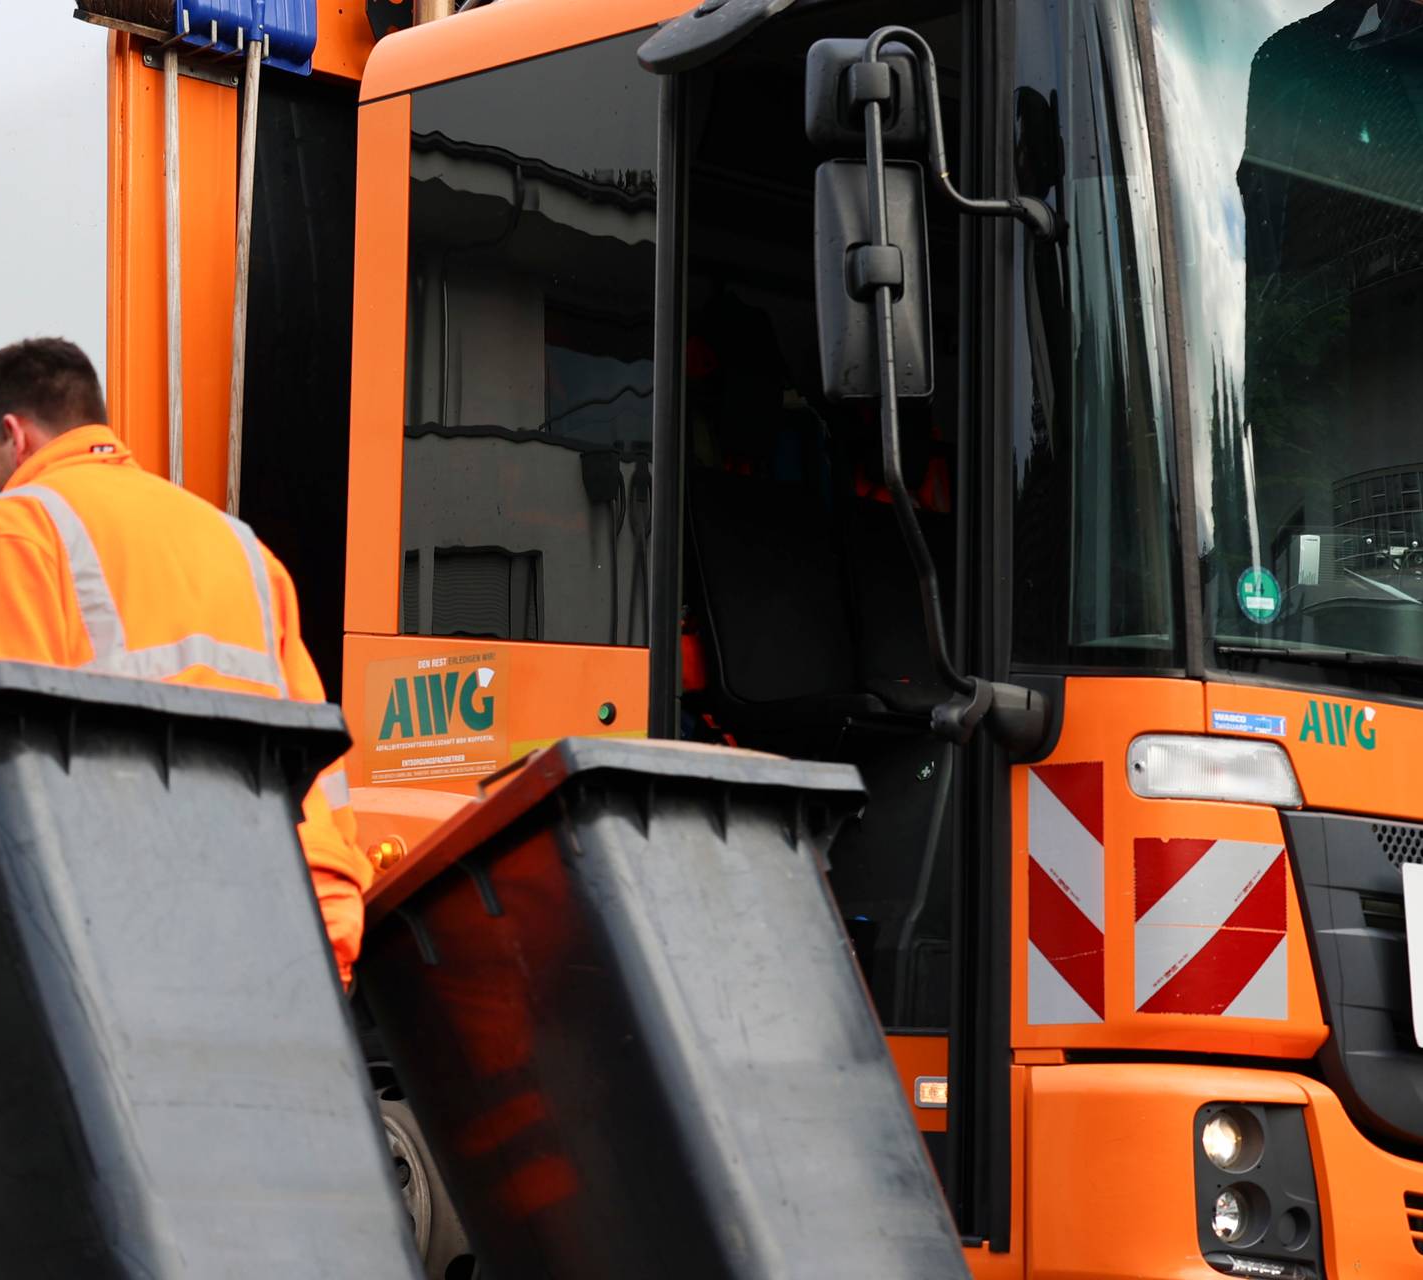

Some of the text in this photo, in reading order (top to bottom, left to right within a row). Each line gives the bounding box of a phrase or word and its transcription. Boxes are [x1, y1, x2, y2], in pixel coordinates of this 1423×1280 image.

[379, 667, 495, 740] AWG
[1213, 712, 1247, 724] WABCO
[1299, 700, 1376, 750] AWG
